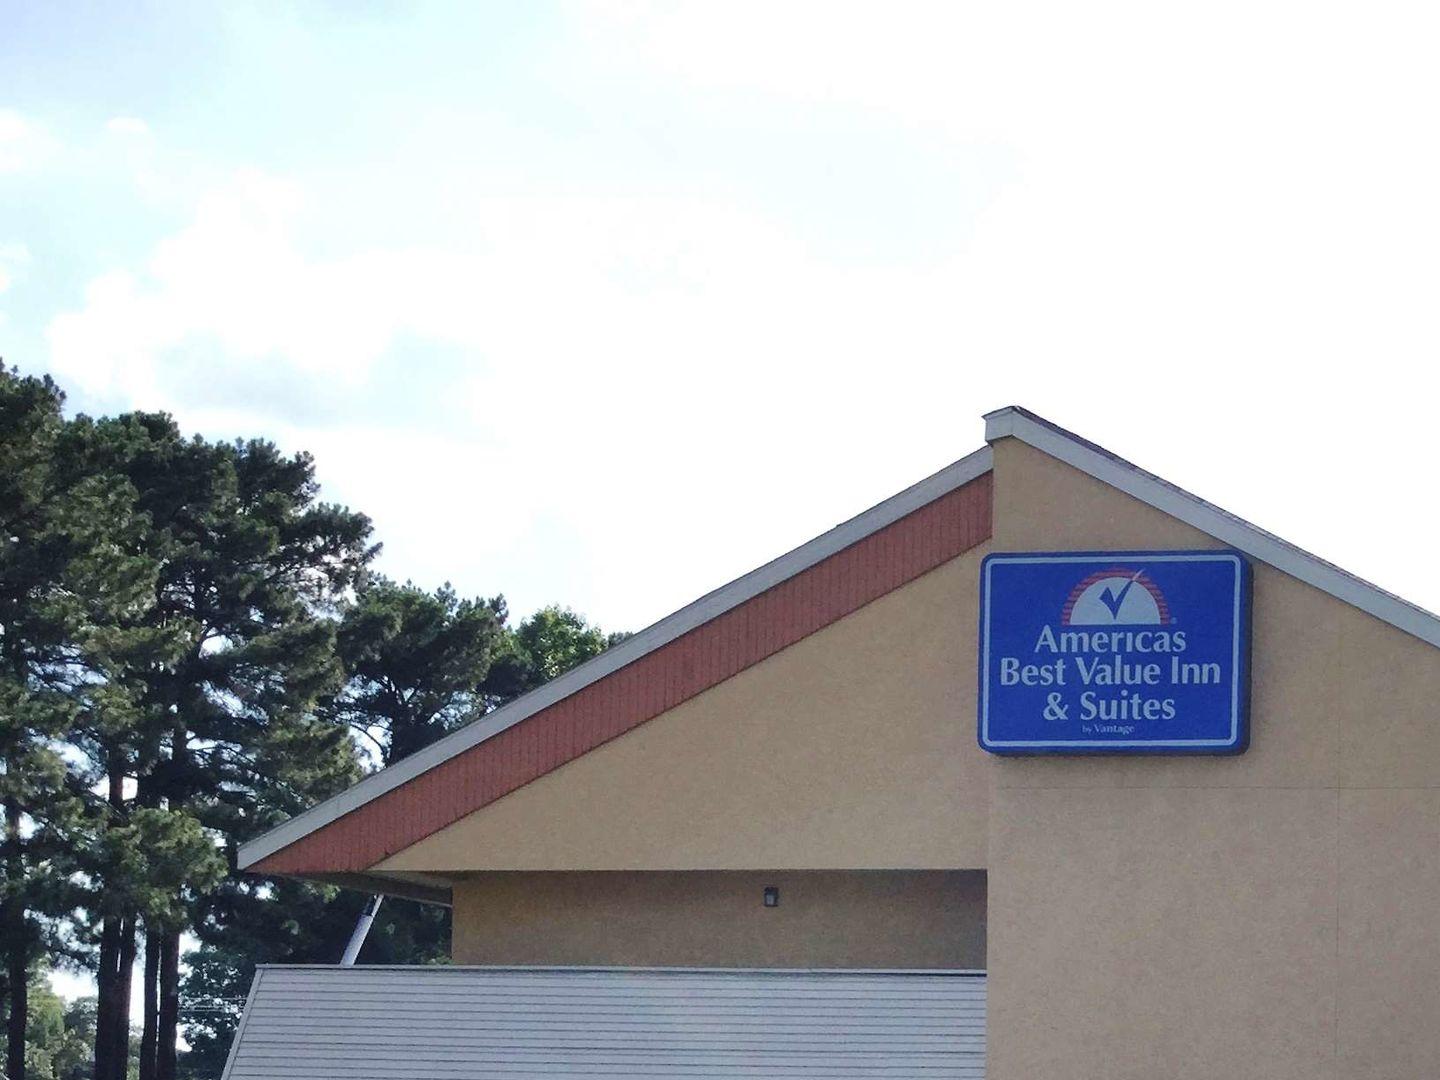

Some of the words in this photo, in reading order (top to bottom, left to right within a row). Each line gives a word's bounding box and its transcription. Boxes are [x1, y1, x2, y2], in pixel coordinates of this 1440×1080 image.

[1034, 625, 1187, 653] Americas
[1000, 657, 1066, 686] Best
[1075, 655, 1161, 685] Value
[1171, 655, 1221, 684] Inn
[1043, 692, 1069, 721] &
[1080, 689, 1176, 721] Suites
[1093, 723, 1135, 735] Vantage
